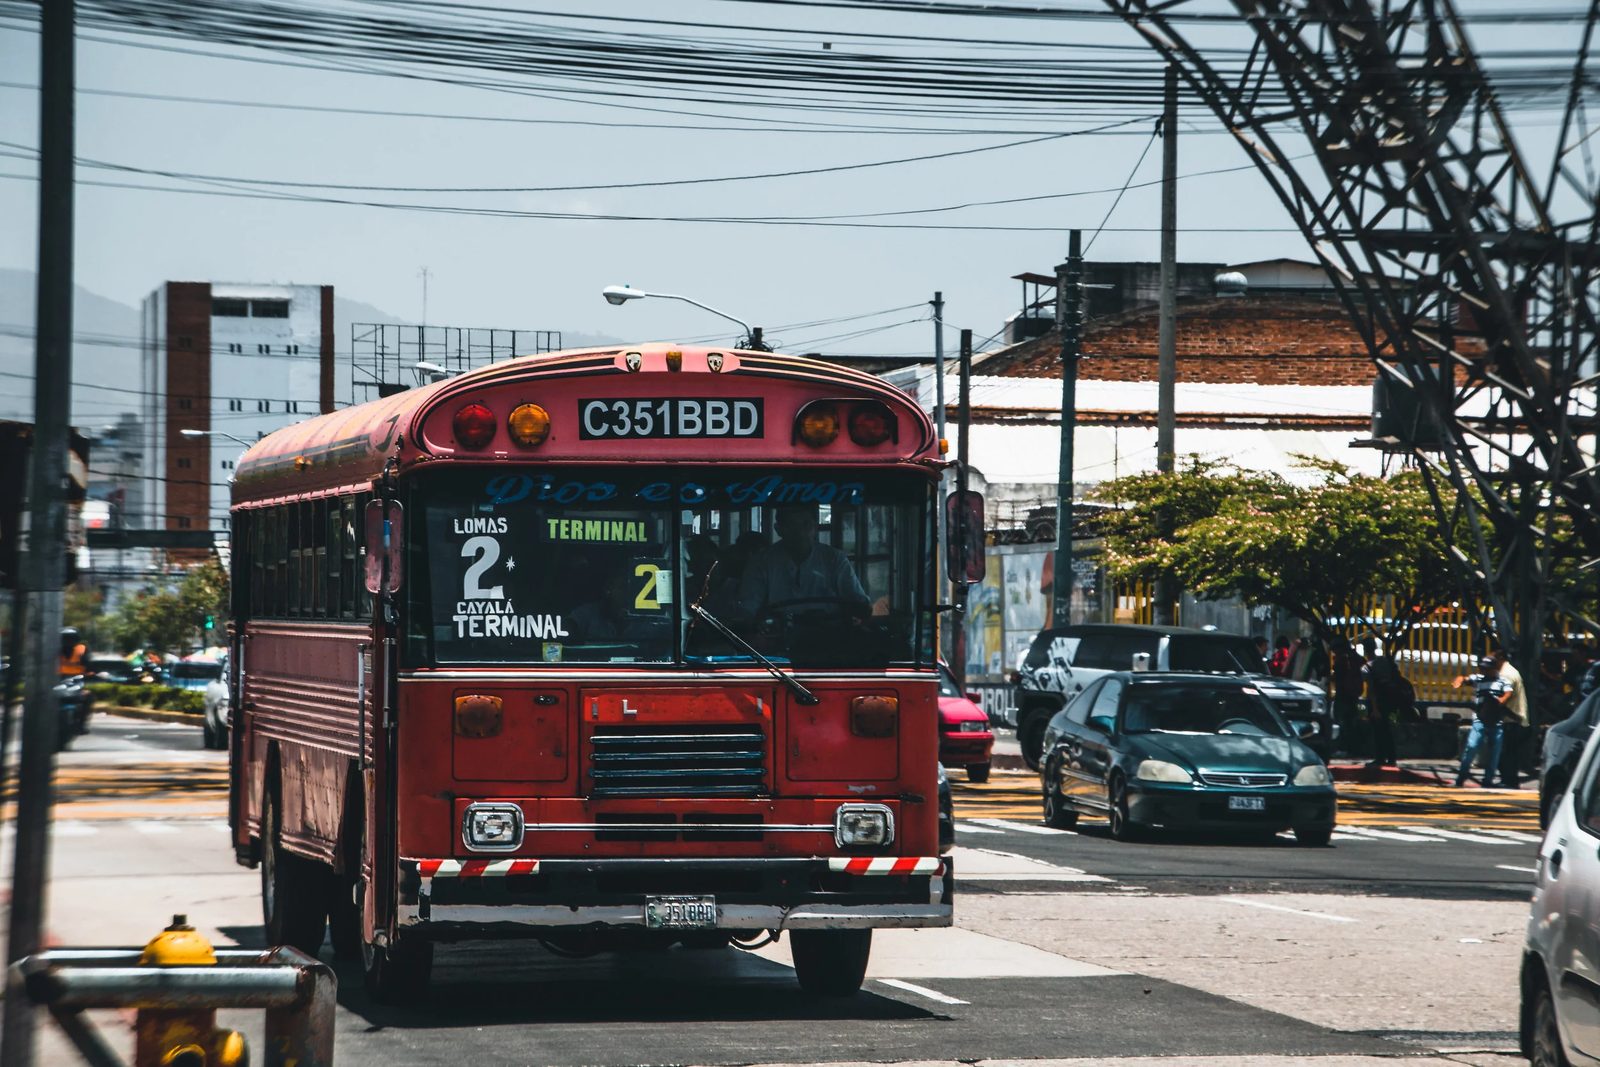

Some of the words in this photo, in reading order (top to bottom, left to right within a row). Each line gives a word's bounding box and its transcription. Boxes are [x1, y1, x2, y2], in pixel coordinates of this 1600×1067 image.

[584, 400, 758, 437] C351BBD
[454, 517, 508, 534] LOMAS
[547, 518, 648, 542] TERMINAL
[461, 535, 505, 600] 2
[634, 563, 661, 610] 2
[456, 599, 514, 614] CAYALÁ
[452, 614, 569, 640] TERMINAL
